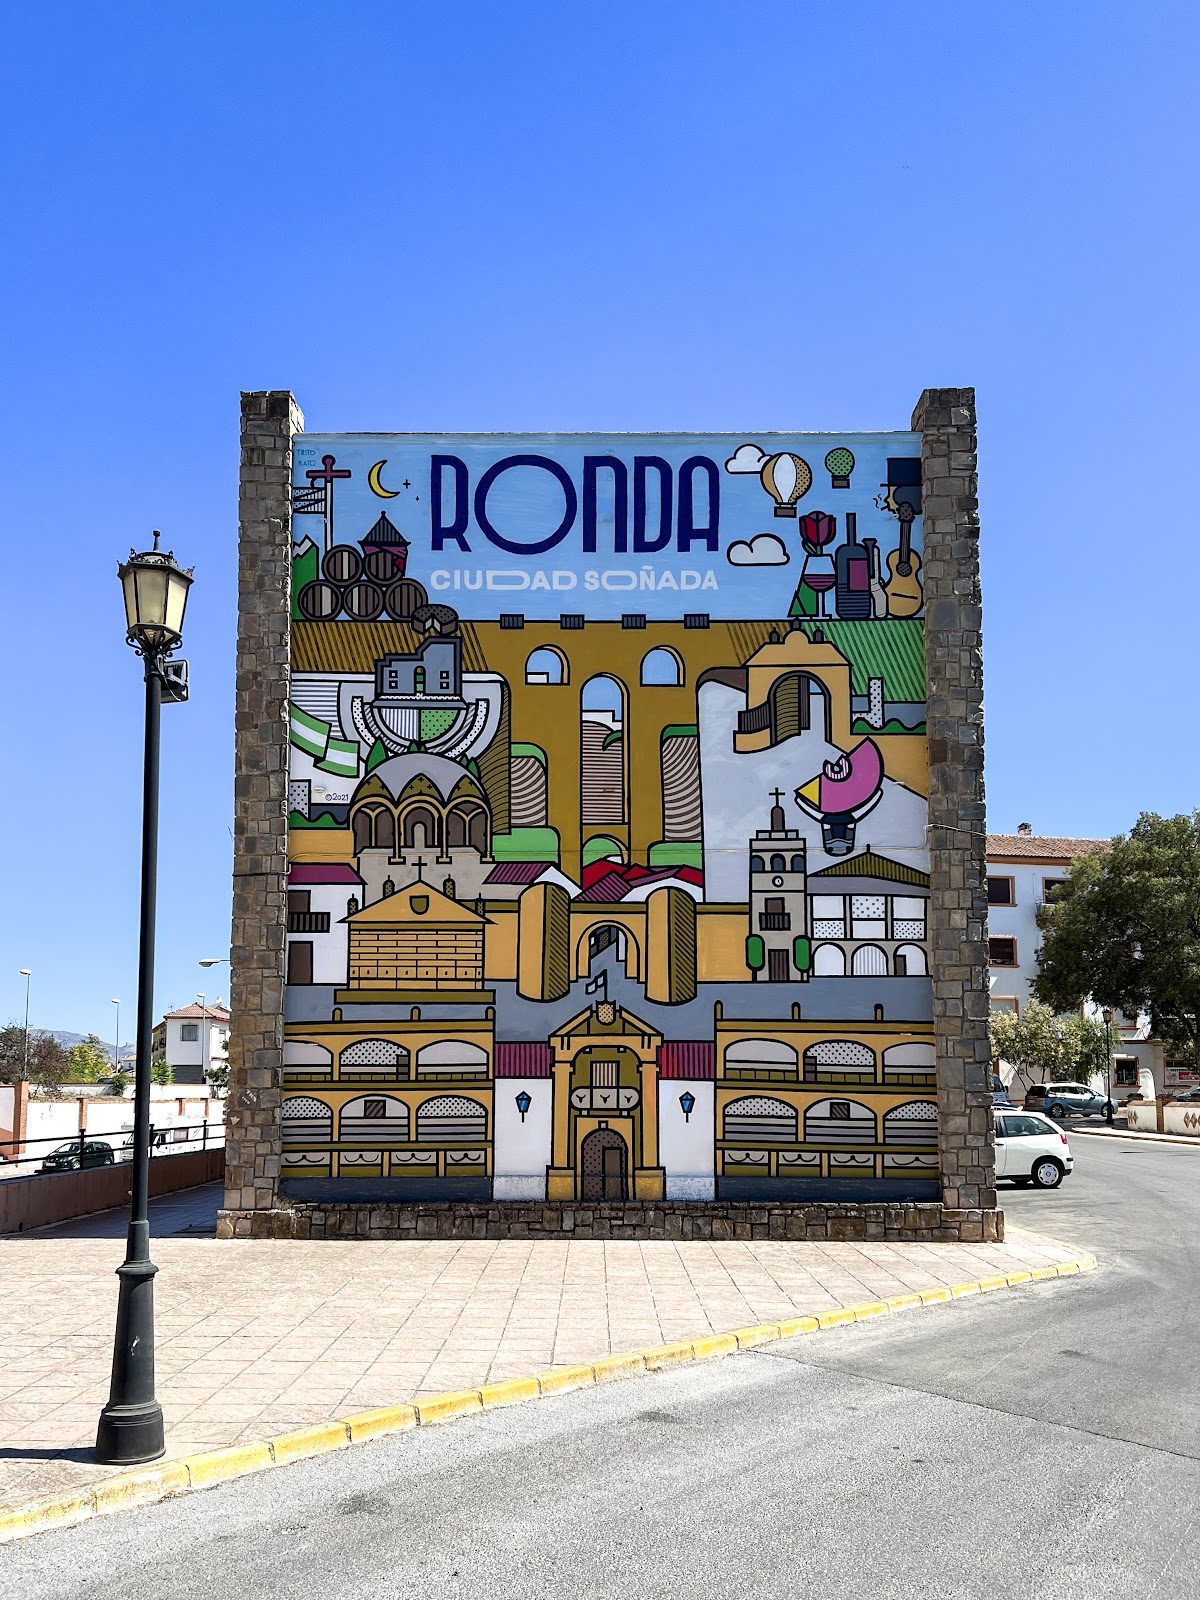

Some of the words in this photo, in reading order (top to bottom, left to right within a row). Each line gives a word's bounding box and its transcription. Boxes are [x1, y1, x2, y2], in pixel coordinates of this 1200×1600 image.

[430, 454, 720, 555] RONDA
[430, 569, 578, 591] CIUDAD
[584, 565, 719, 591] SOÑADA
